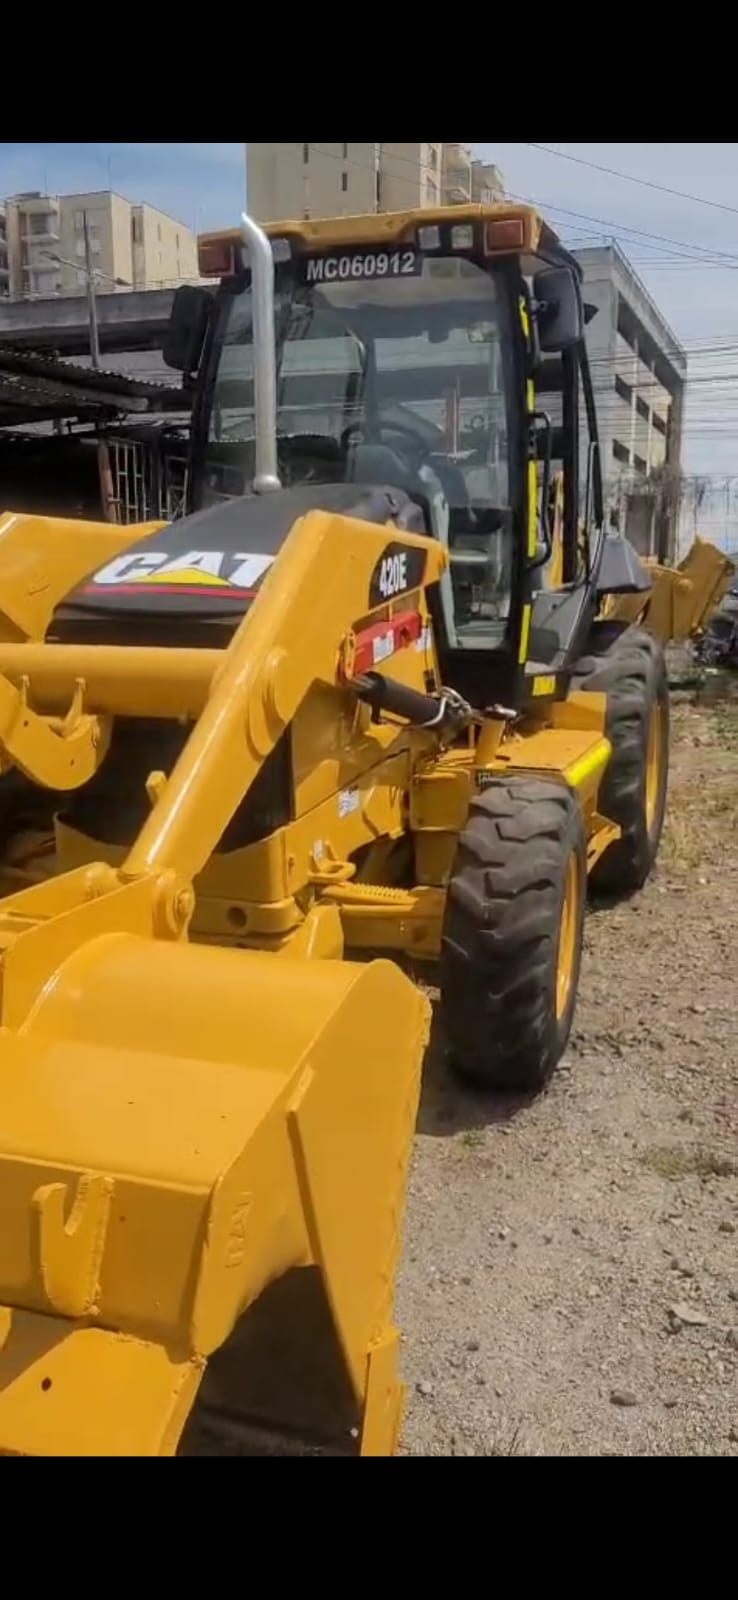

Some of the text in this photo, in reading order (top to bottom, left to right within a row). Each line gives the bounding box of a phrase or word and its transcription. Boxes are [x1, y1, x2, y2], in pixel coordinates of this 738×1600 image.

[306, 252, 415, 280] MC060912
[93, 551, 276, 588] CAT
[380, 552, 407, 597] 420E
